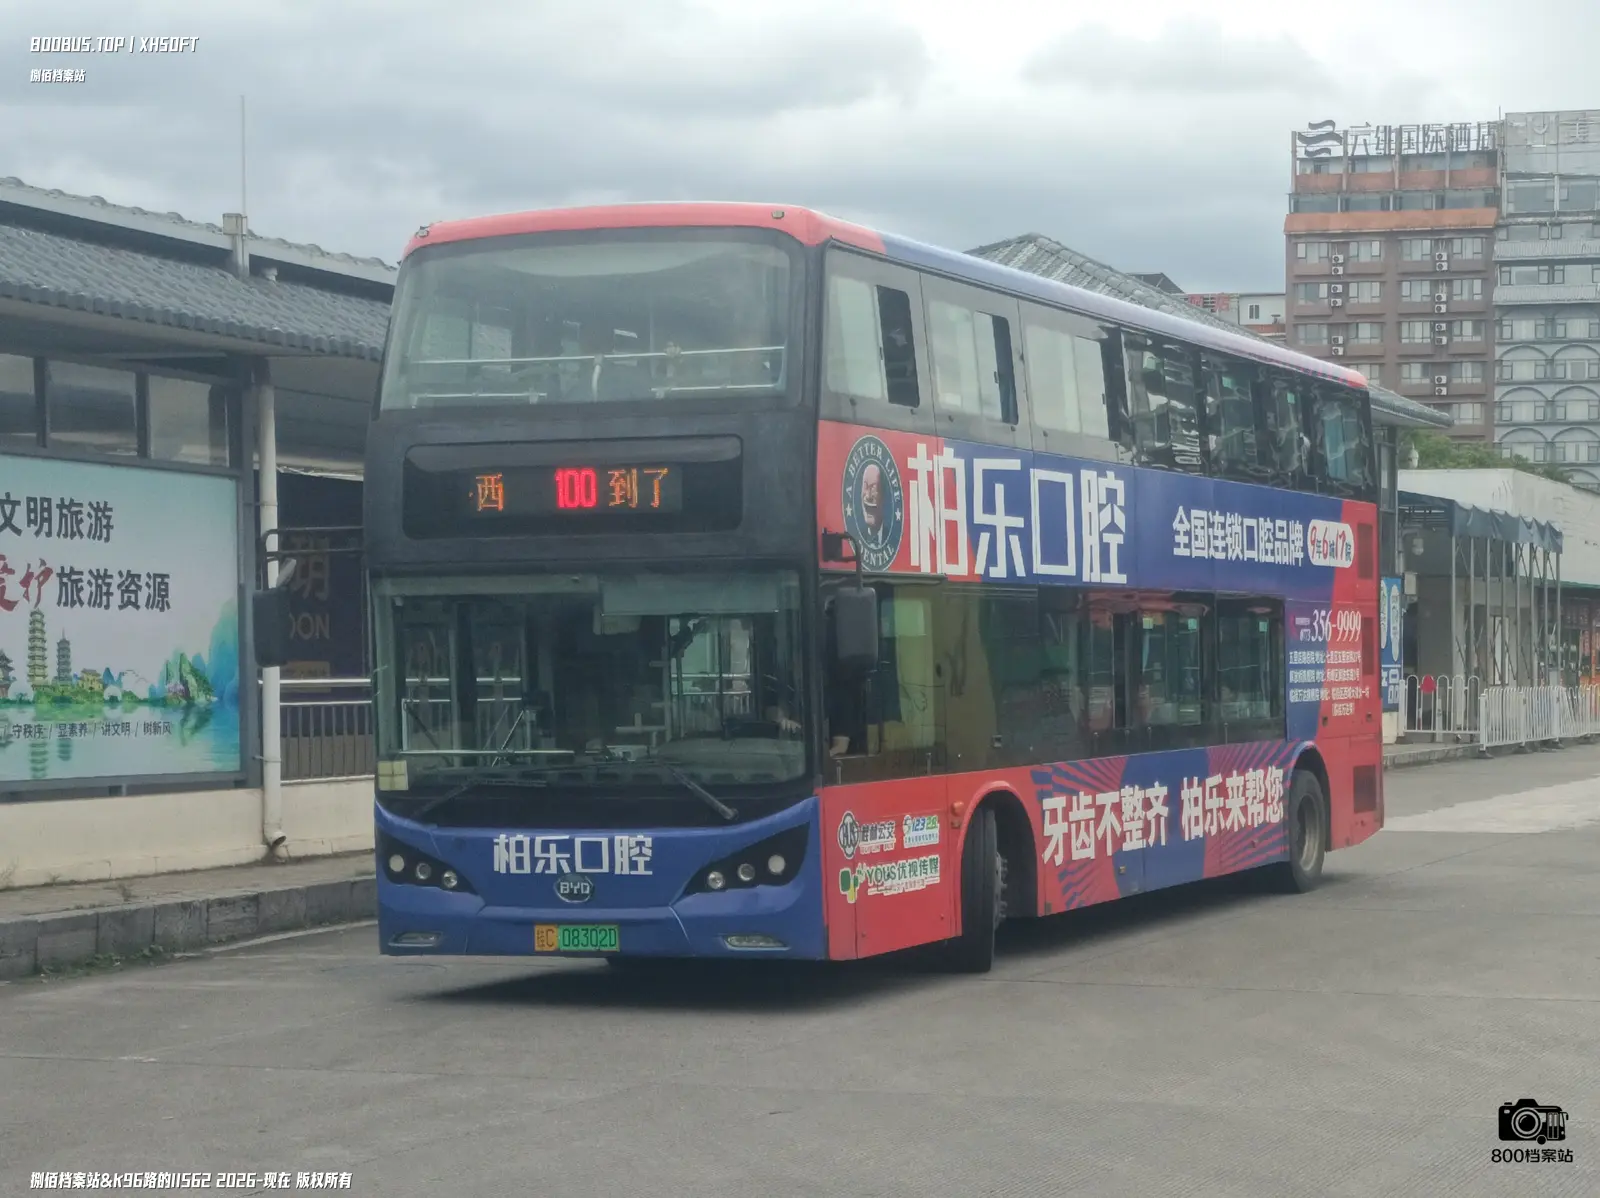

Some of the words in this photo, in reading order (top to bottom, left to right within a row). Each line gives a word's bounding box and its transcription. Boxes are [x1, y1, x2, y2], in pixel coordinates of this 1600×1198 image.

[556, 467, 597, 509] 100
[608, 468, 668, 508] 到了
[848, 442, 883, 479] BETTER
[884, 458, 902, 503] LIFE
[0, 491, 114, 543] 文明旅游
[907, 443, 1128, 584] 柏乐口腔
[1172, 505, 1304, 567] 全国连锁口腔品牌
[1042, 781, 1169, 866] 牙齿不整齐
[1181, 765, 1284, 841] 柏乐来帮您
[493, 834, 653, 875] 柏乐口腔
[560, 881, 590, 894] BYD
